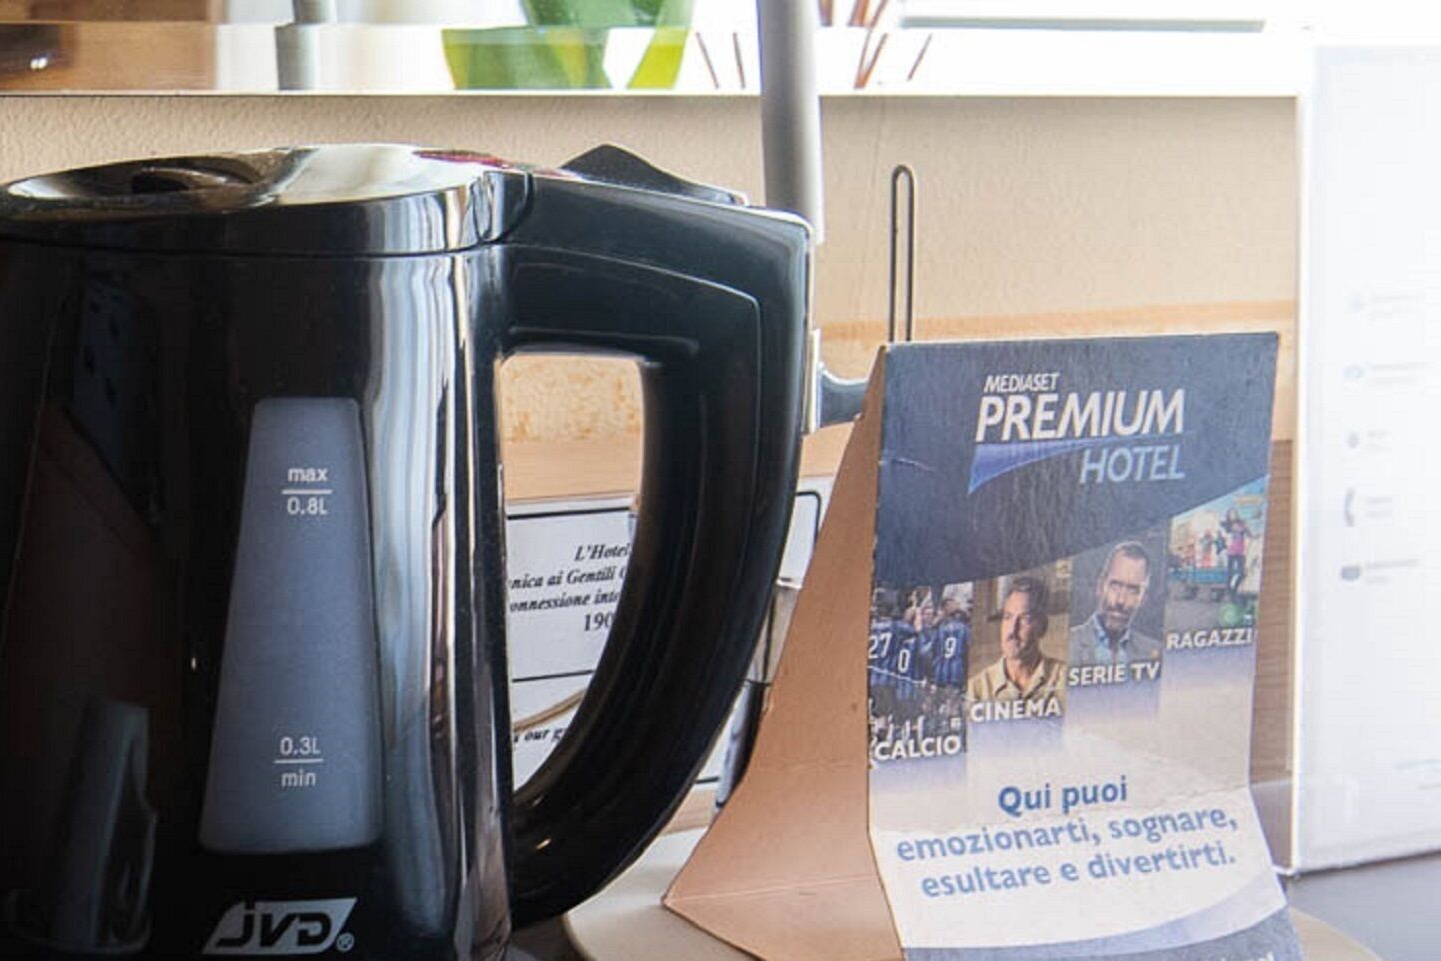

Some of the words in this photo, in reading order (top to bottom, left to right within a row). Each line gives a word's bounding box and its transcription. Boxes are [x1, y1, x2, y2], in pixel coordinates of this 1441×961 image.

[983, 372, 1059, 392] MEDIASET
[975, 388, 1185, 442] PREMIUM
[287, 466, 329, 483] max
[1078, 444, 1185, 484] HOTEL
[286, 496, 328, 515] 0.8L
[509, 572, 544, 589] nica
[547, 570, 564, 586] ai
[567, 566, 616, 584] Gentili
[509, 592, 591, 612] onnessione
[944, 636, 958, 660] 9
[1166, 628, 1255, 650] RAGAZZI
[1068, 664, 1126, 686] SERIE
[1131, 661, 1162, 682] TV
[970, 697, 1063, 723] CINEMA
[279, 736, 321, 756] 0.3L
[874, 734, 962, 762] CALCIO
[280, 769, 317, 787] min
[998, 783, 1053, 817] Qui
[1062, 775, 1129, 813] puoi
[896, 819, 1101, 861] emozionarti,
[1110, 805, 1238, 843] sognare,
[921, 855, 1052, 898] esultare
[1059, 863, 1080, 883] e
[1087, 841, 1236, 880] divertirti.
